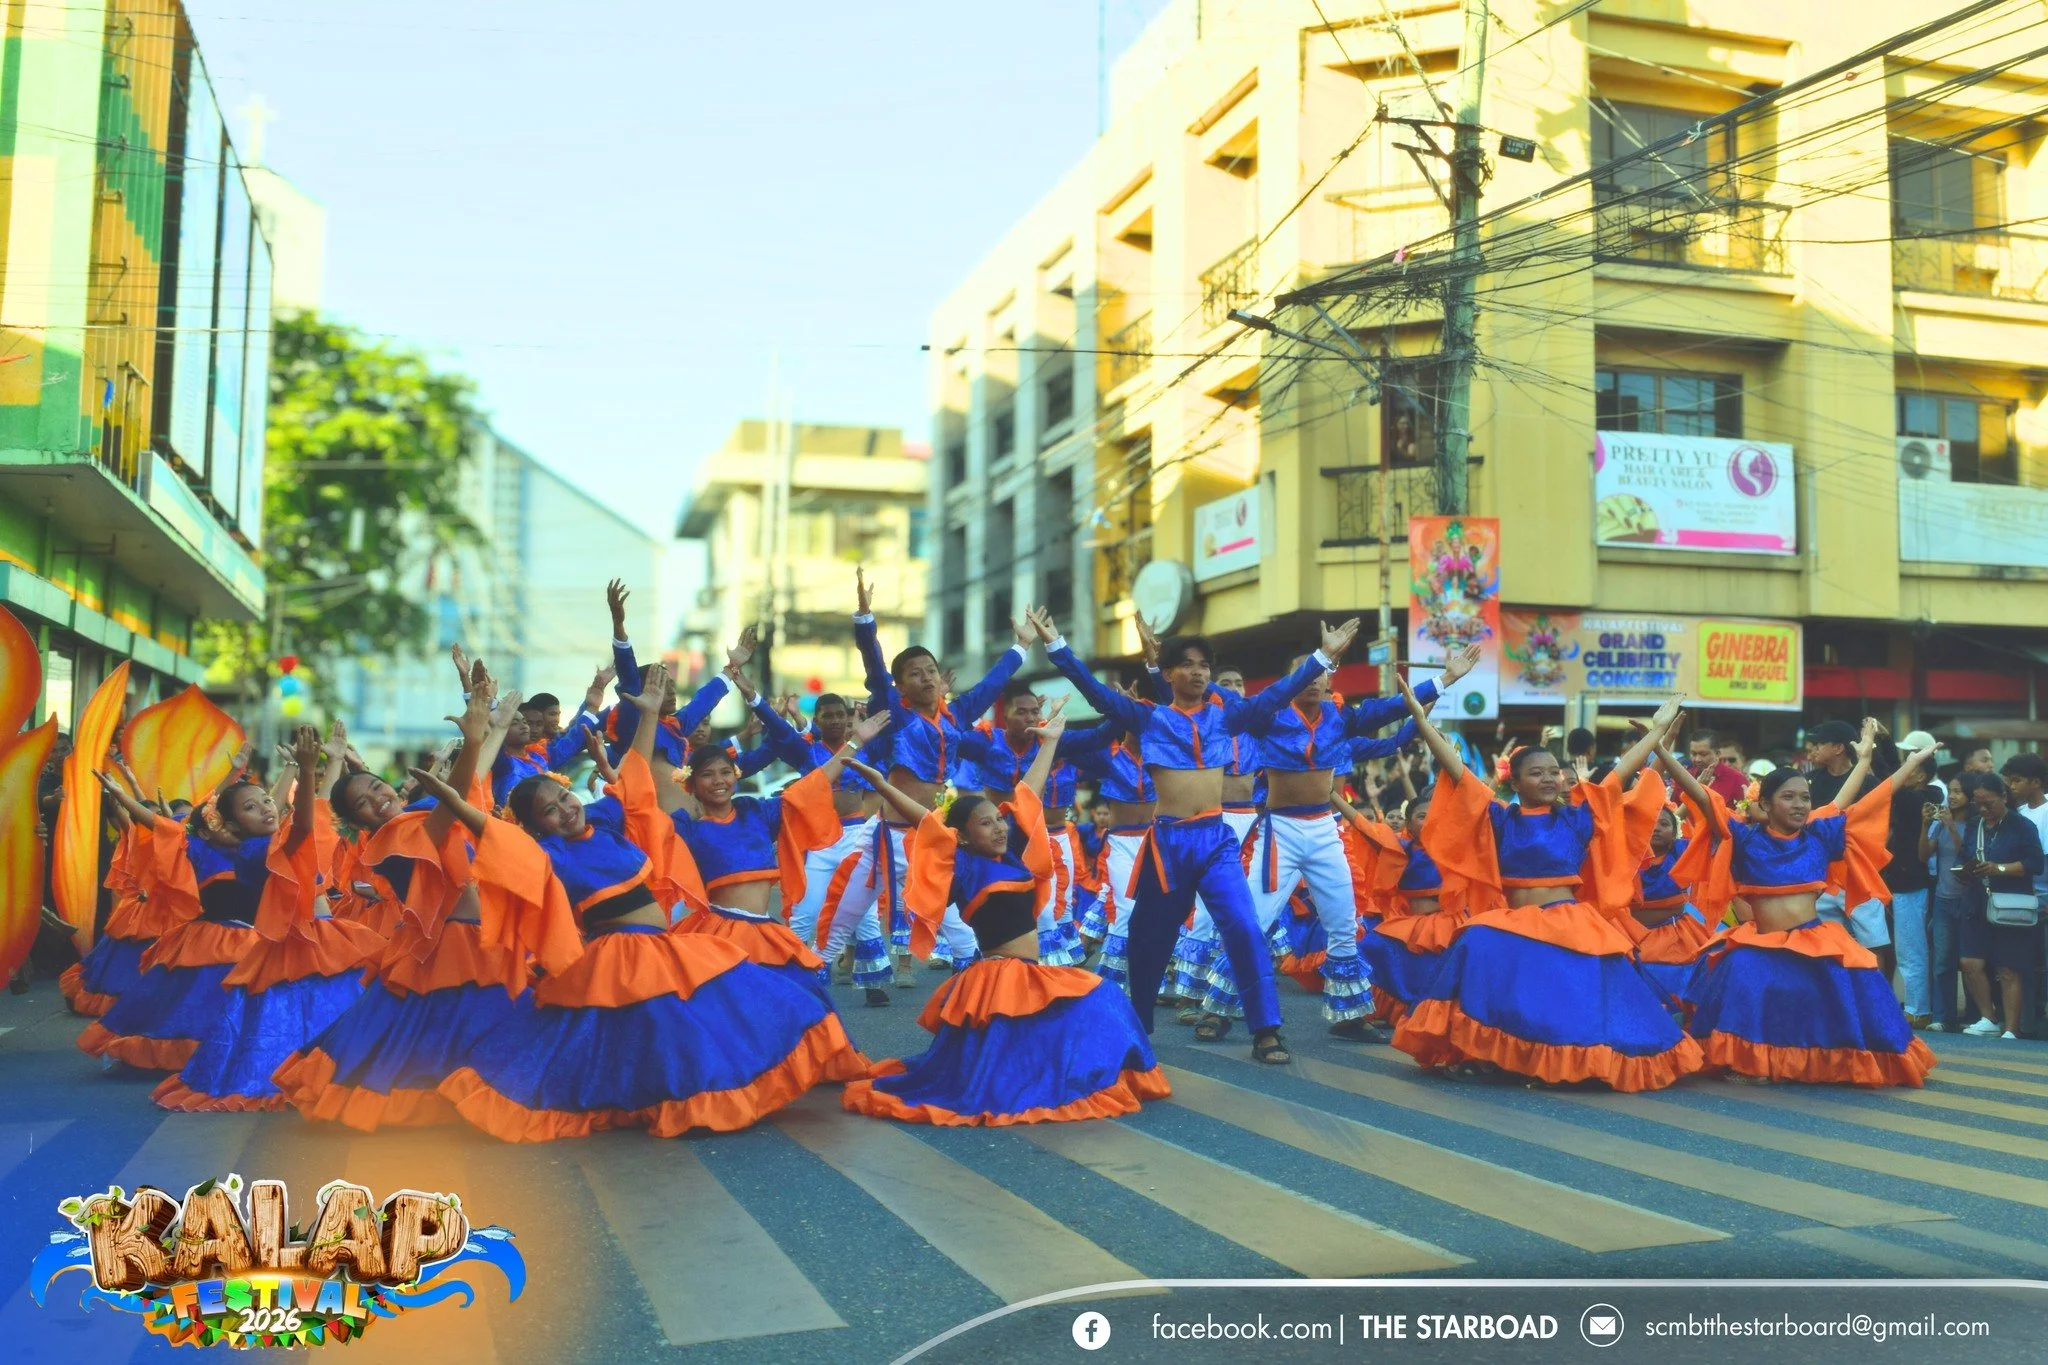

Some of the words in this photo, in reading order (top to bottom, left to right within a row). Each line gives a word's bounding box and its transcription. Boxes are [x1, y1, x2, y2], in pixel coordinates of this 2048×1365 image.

[1611, 445, 1685, 464] PRETTY
[1692, 451, 1715, 466] YU
[1623, 464, 1655, 475] HAIR
[1659, 467, 1691, 477] CARE
[1617, 475, 1667, 488] BEAUTY
[1671, 479, 1714, 490] SALON
[1598, 632, 1666, 650] GRAND
[1706, 631, 1789, 663] GINEBRA
[1582, 651, 1682, 669] CELEBRITY
[1586, 670, 1677, 688] CONCERT
[1706, 661, 1735, 678] SAN
[1740, 664, 1789, 682] MIGUEL
